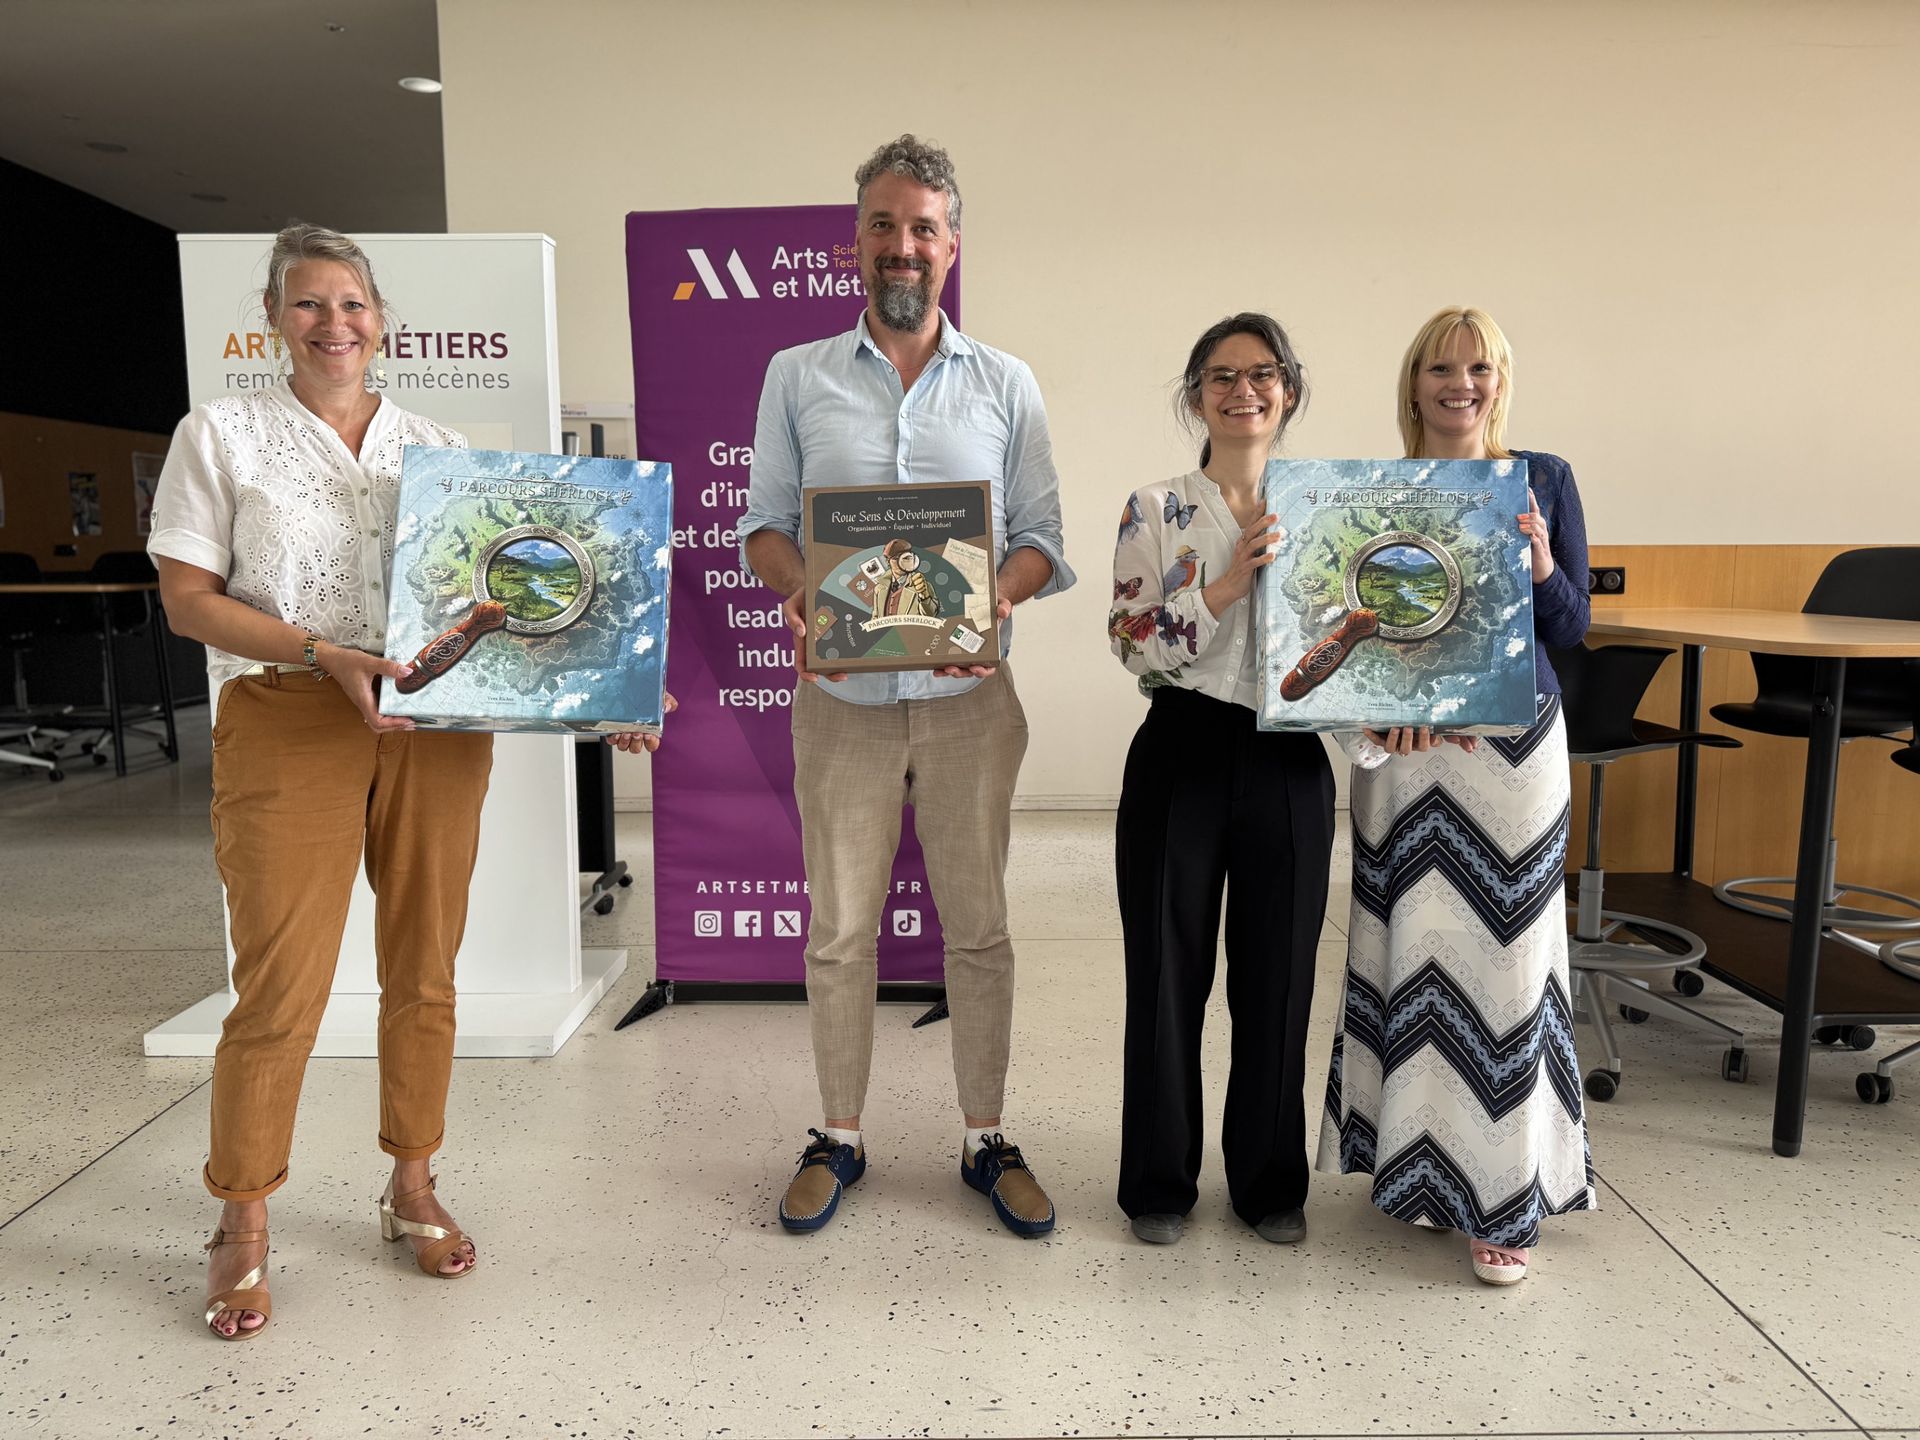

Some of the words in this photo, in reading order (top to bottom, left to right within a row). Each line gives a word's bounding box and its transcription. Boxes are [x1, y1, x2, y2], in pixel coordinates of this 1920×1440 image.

[771, 246, 828, 270] Arts
[832, 244, 857, 255] Scie
[832, 257, 860, 268] Tech
[772, 275, 798, 299] et
[807, 272, 869, 297] Mét
[223, 332, 282, 359] ART
[226, 373, 287, 389] rem
[398, 365, 510, 389] mécènes
[708, 441, 754, 467] Gra
[458, 481, 536, 496] PARCOURS
[540, 487, 614, 502] SHERLOCK
[700, 481, 750, 508] d’in
[1323, 491, 1397, 503] PARCOURS
[1402, 492, 1477, 505] SHERLOCK
[831, 511, 856, 523] Roue
[859, 509, 881, 522] Sens
[884, 509, 895, 521] &
[897, 507, 966, 522] Développement
[847, 525, 887, 533] Organisation
[893, 523, 914, 532] Équipe
[921, 521, 952, 529] Individuel
[672, 525, 698, 548] et
[703, 522, 748, 548] de
[727, 603, 788, 629] lead
[867, 617, 902, 629] PARCOURS
[903, 616, 937, 627] SHERLOCK
[738, 642, 795, 668] indu
[719, 688, 796, 713] respo
[696, 881, 922, 894] ARTSETME.FR
